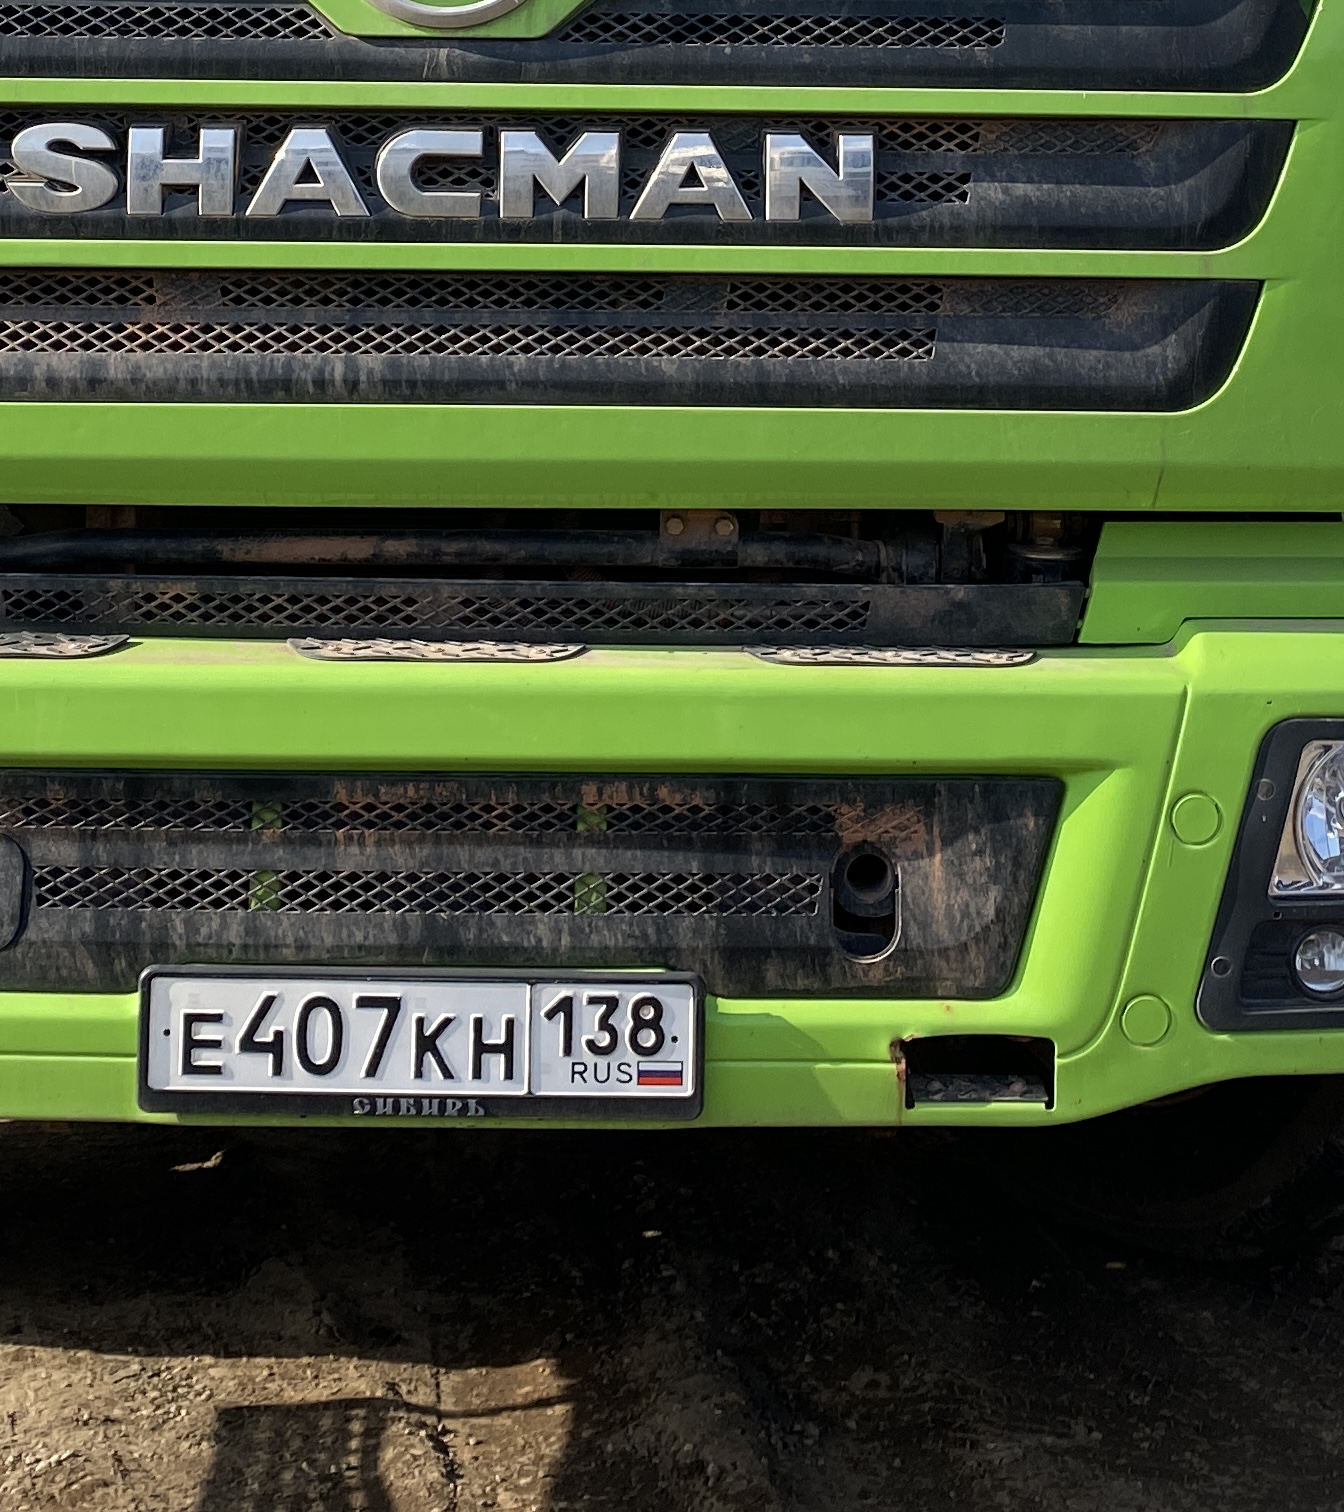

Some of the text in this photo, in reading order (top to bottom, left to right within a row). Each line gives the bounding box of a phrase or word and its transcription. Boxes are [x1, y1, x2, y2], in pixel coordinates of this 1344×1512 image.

[8, 122, 875, 221] SHACMAN
[541, 992, 665, 1058] 138
[570, 1060, 632, 1085] RUS
[353, 1097, 485, 1117] СИБИРЬ
